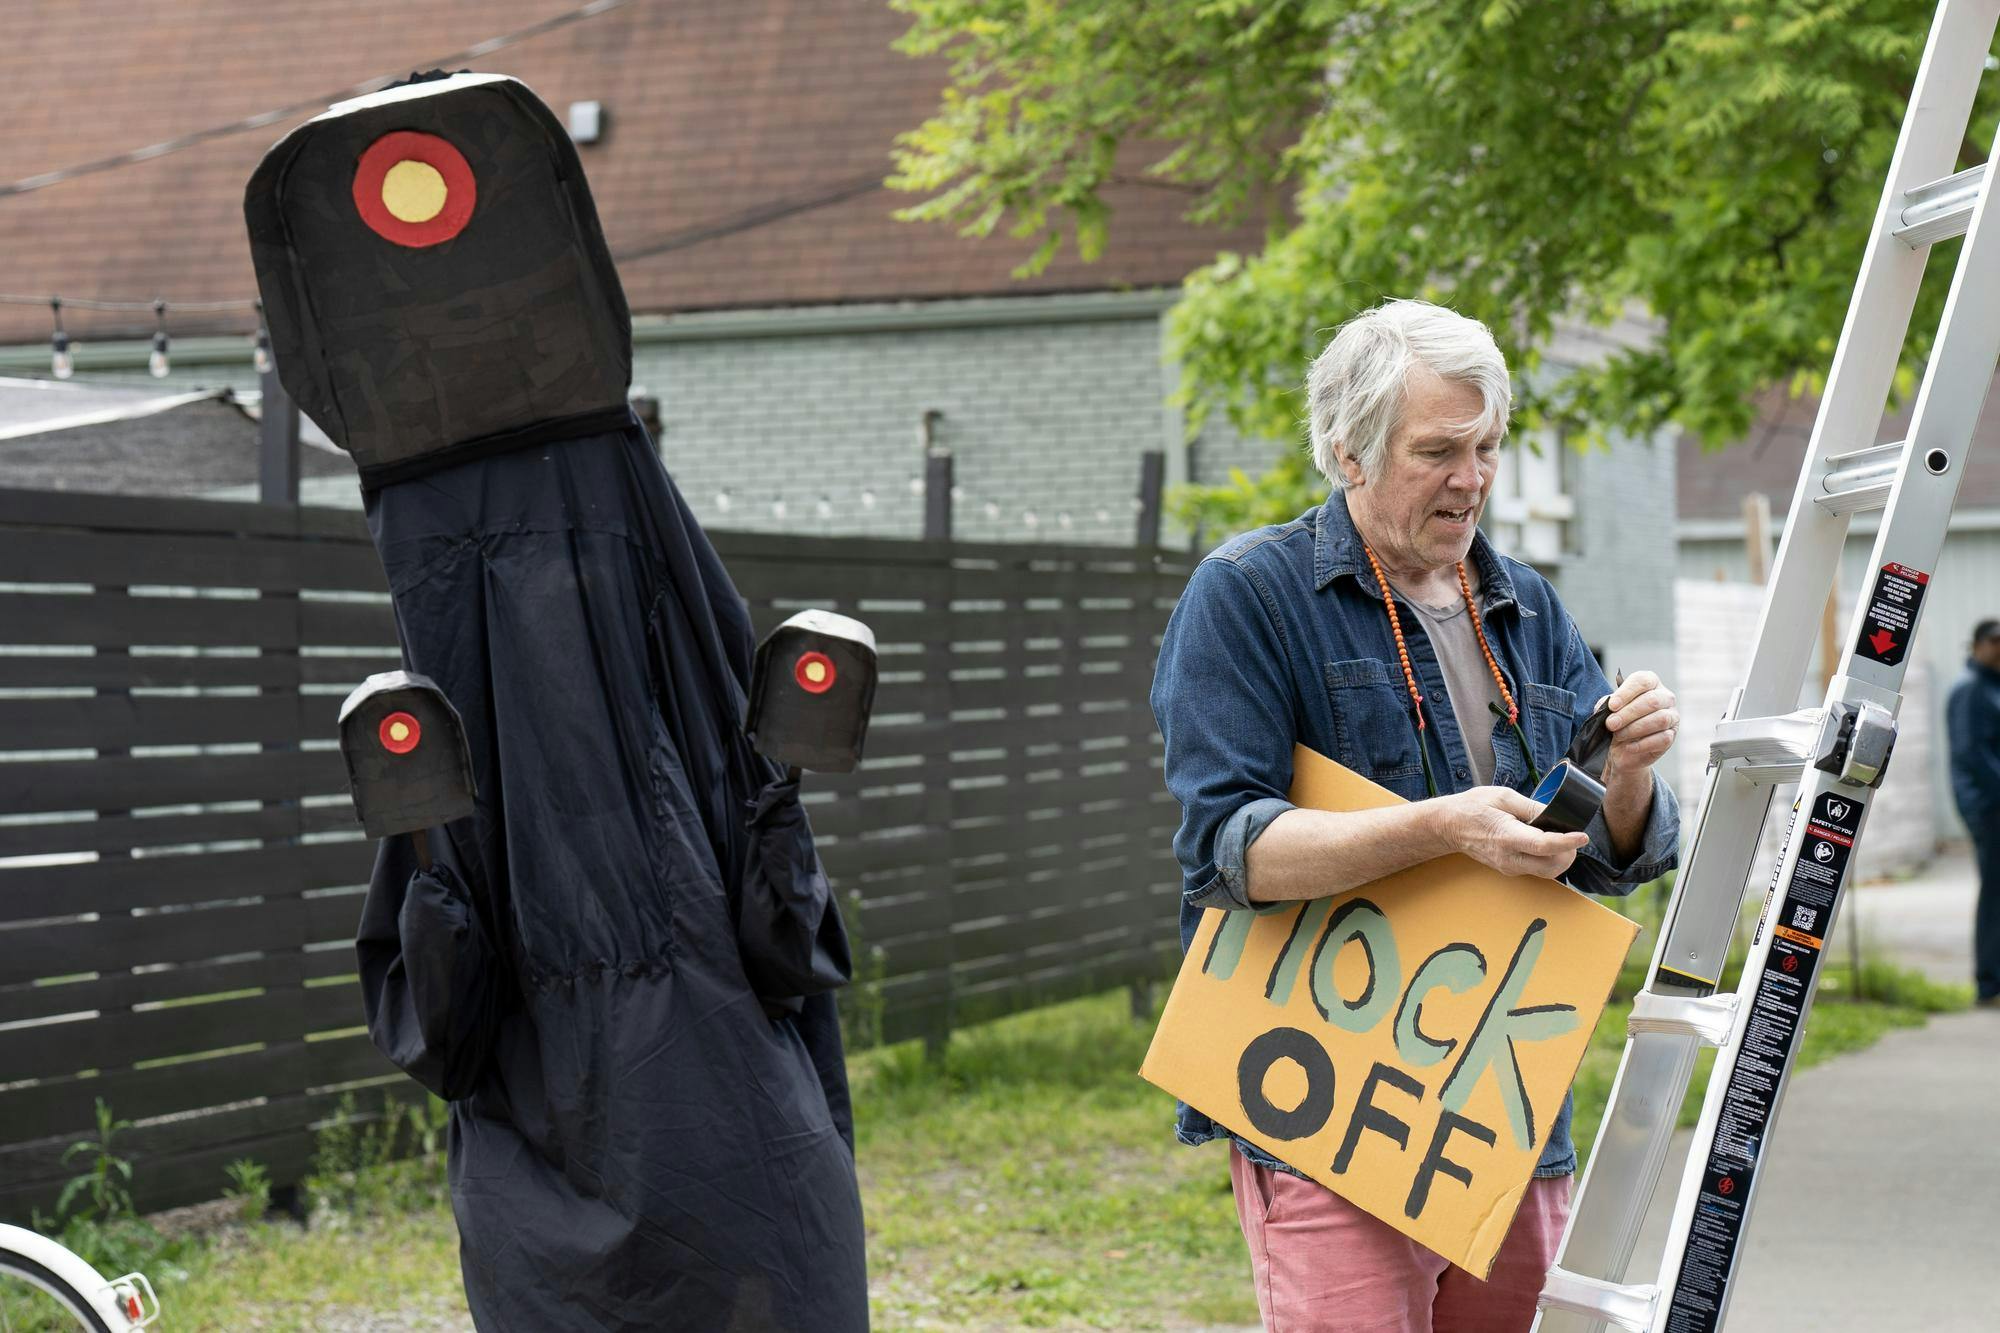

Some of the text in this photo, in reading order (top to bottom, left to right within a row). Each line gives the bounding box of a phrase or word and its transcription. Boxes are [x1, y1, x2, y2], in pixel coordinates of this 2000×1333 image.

[1902, 566, 1919, 576] DANGER
[1812, 818, 1832, 828] SAFETY
[1237, 1027, 1497, 1219] OFF
